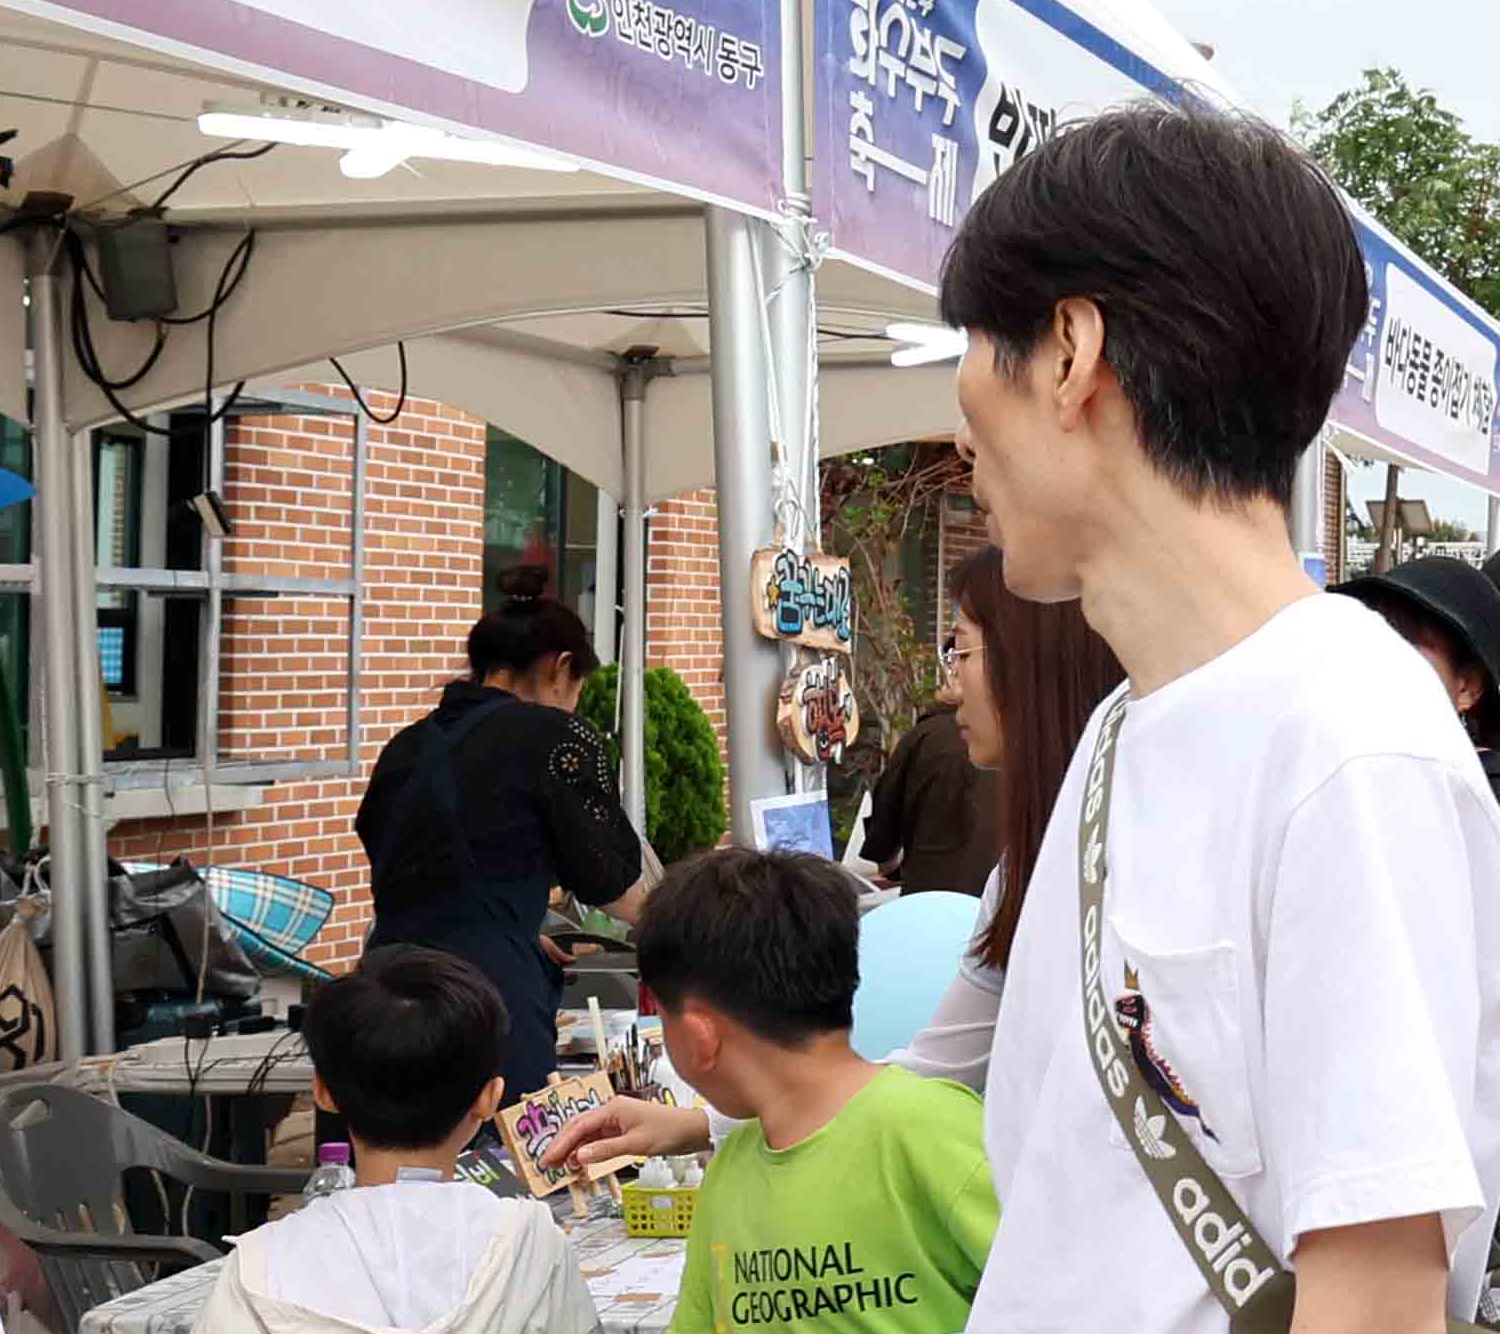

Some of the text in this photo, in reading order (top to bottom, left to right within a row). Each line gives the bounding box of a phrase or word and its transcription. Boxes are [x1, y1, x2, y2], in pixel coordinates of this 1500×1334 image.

[717, 32, 764, 89] 동구
[1385, 317, 1431, 402] 바다동물
[1430, 348, 1472, 427] 종이접기
[1084, 905, 1130, 1098] adidas
[734, 1242, 864, 1283] NATIONAL
[731, 1272, 918, 1325] GEOGRAPHIC
